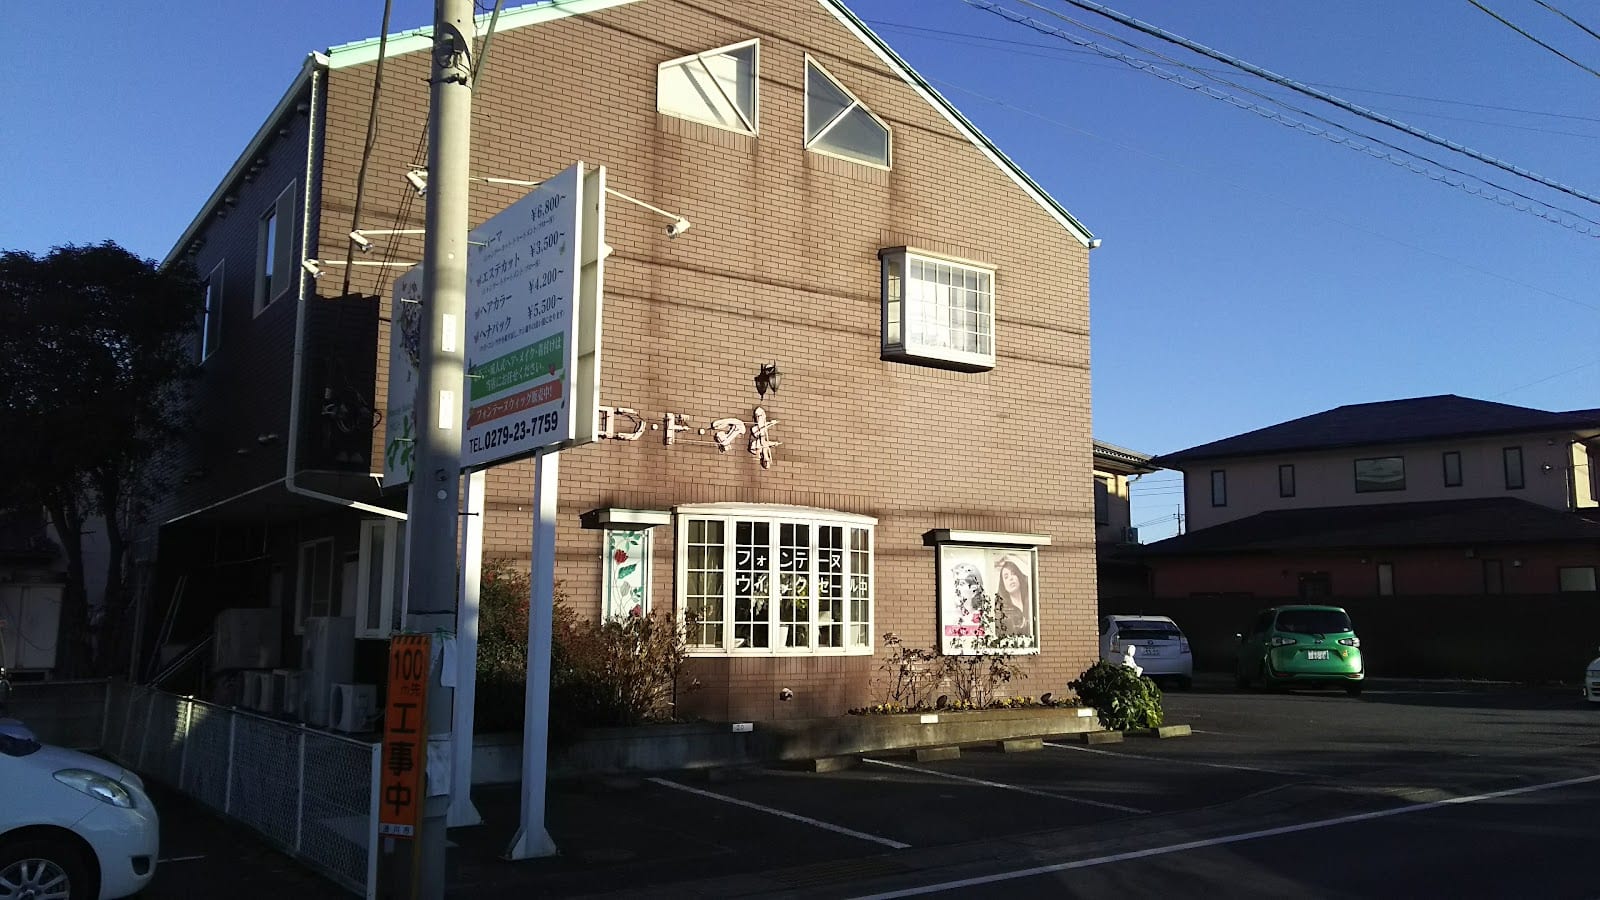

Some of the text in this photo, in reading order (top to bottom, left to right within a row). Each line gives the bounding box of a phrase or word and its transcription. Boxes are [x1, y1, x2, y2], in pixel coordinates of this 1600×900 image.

[481, 294, 512, 315] ヘアカラー
[737, 550, 841, 572] フォンテーヌ
[395, 649, 423, 680] 100
[385, 702, 417, 816] 工事中
